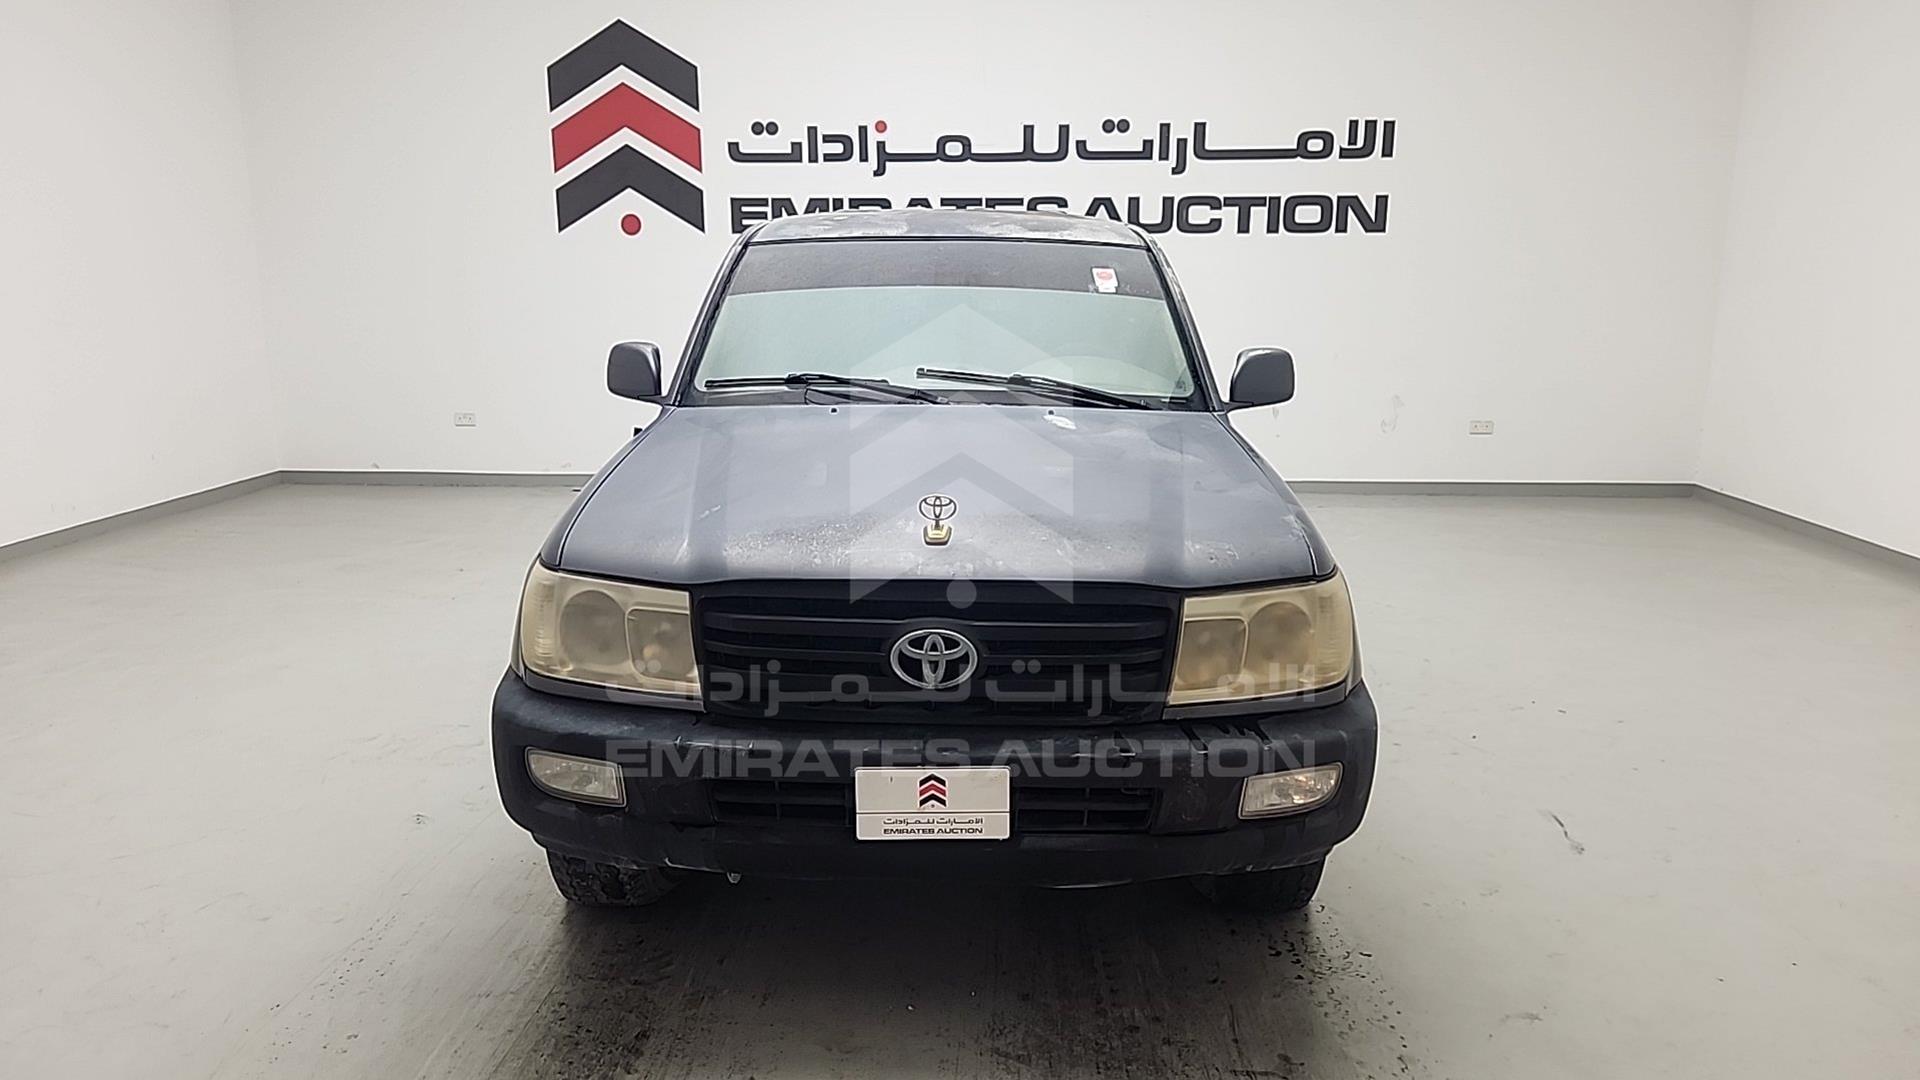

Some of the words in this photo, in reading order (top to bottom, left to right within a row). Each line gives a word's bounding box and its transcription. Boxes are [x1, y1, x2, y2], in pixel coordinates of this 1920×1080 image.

[727, 119, 1070, 177] للمزادات
[1075, 118, 1396, 175] الامارات
[1084, 194, 1389, 234] AUCTION
